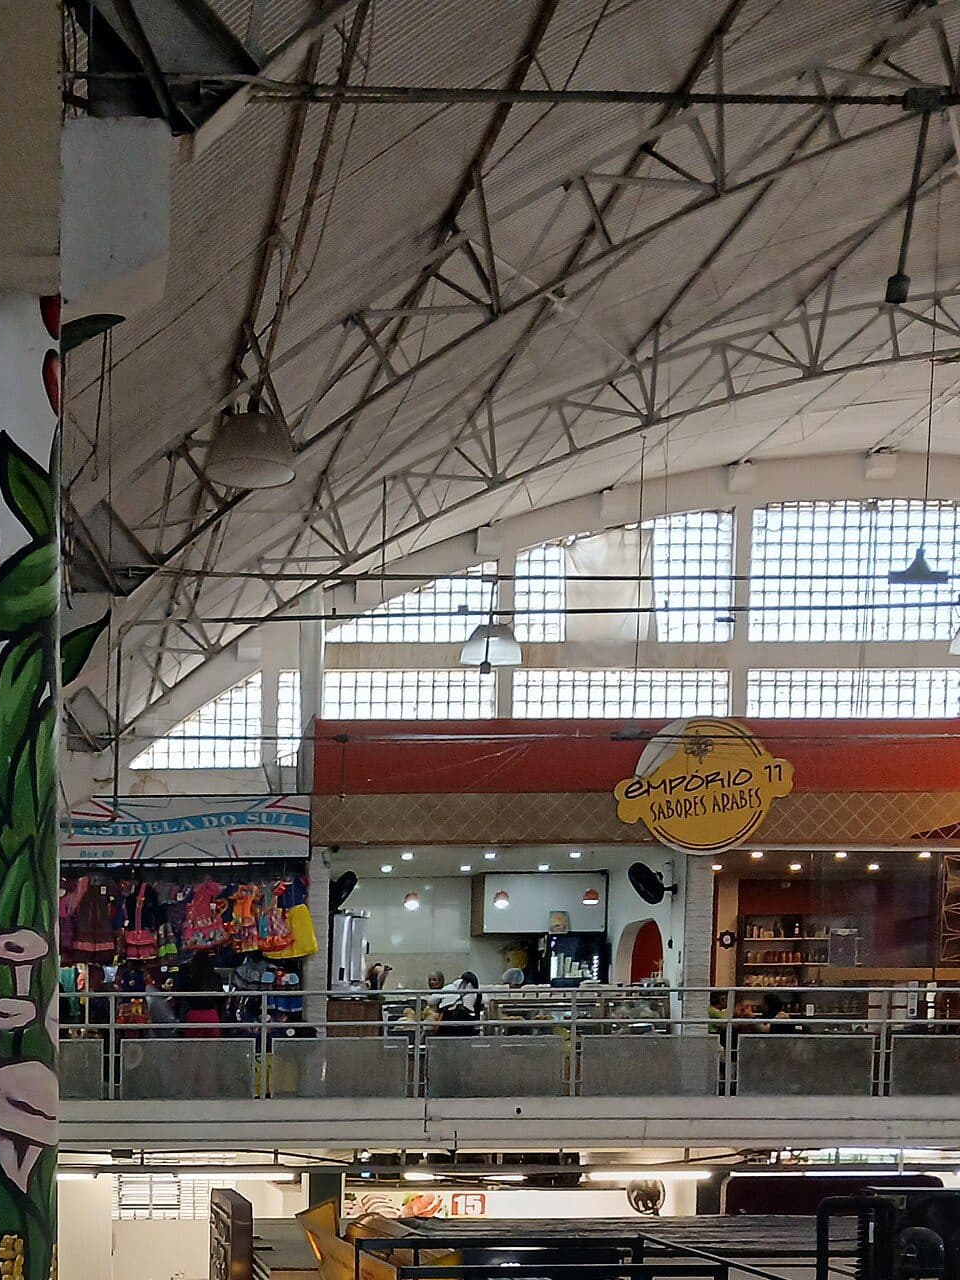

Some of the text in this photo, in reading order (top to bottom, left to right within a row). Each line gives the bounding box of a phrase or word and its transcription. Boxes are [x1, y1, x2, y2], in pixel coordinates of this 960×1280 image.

[764, 764, 783, 783] 11
[650, 787, 763, 823] SABORES ÁRABES
[201, 814, 237, 828] DO
[245, 812, 294, 825] SUL
[453, 1195, 482, 1216] 15
